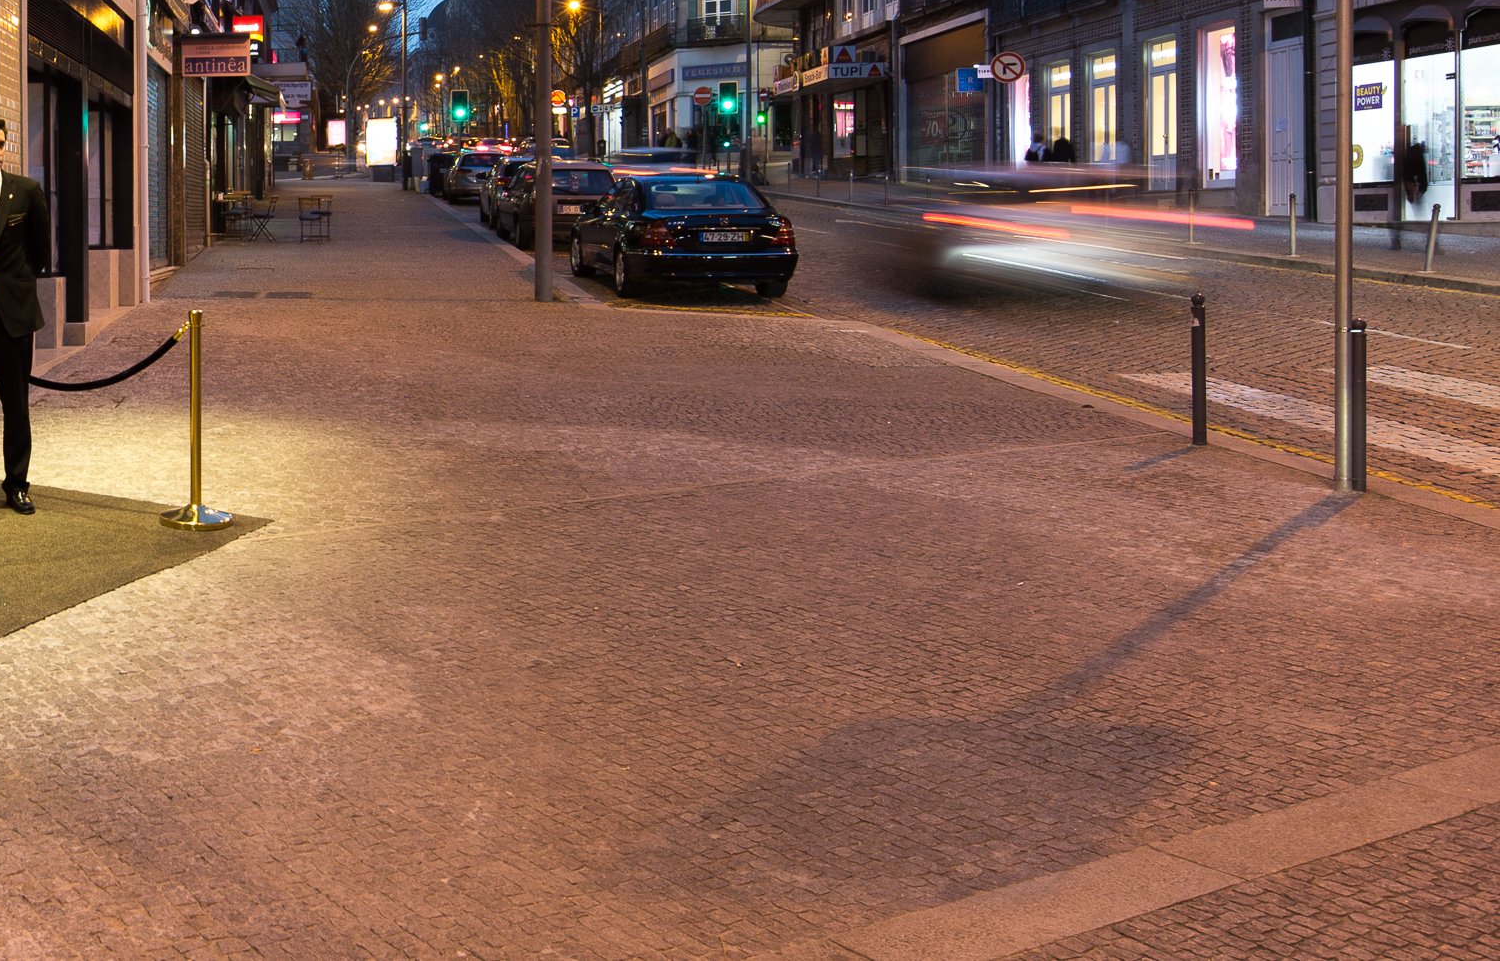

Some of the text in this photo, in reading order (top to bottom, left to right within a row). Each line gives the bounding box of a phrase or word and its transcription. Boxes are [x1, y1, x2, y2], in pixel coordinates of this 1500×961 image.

[185, 58, 247, 73] antinêa
[1356, 85, 1381, 97] BEAUTY
[1356, 95, 1380, 106] POWER
[571, 107, 578, 117] P
